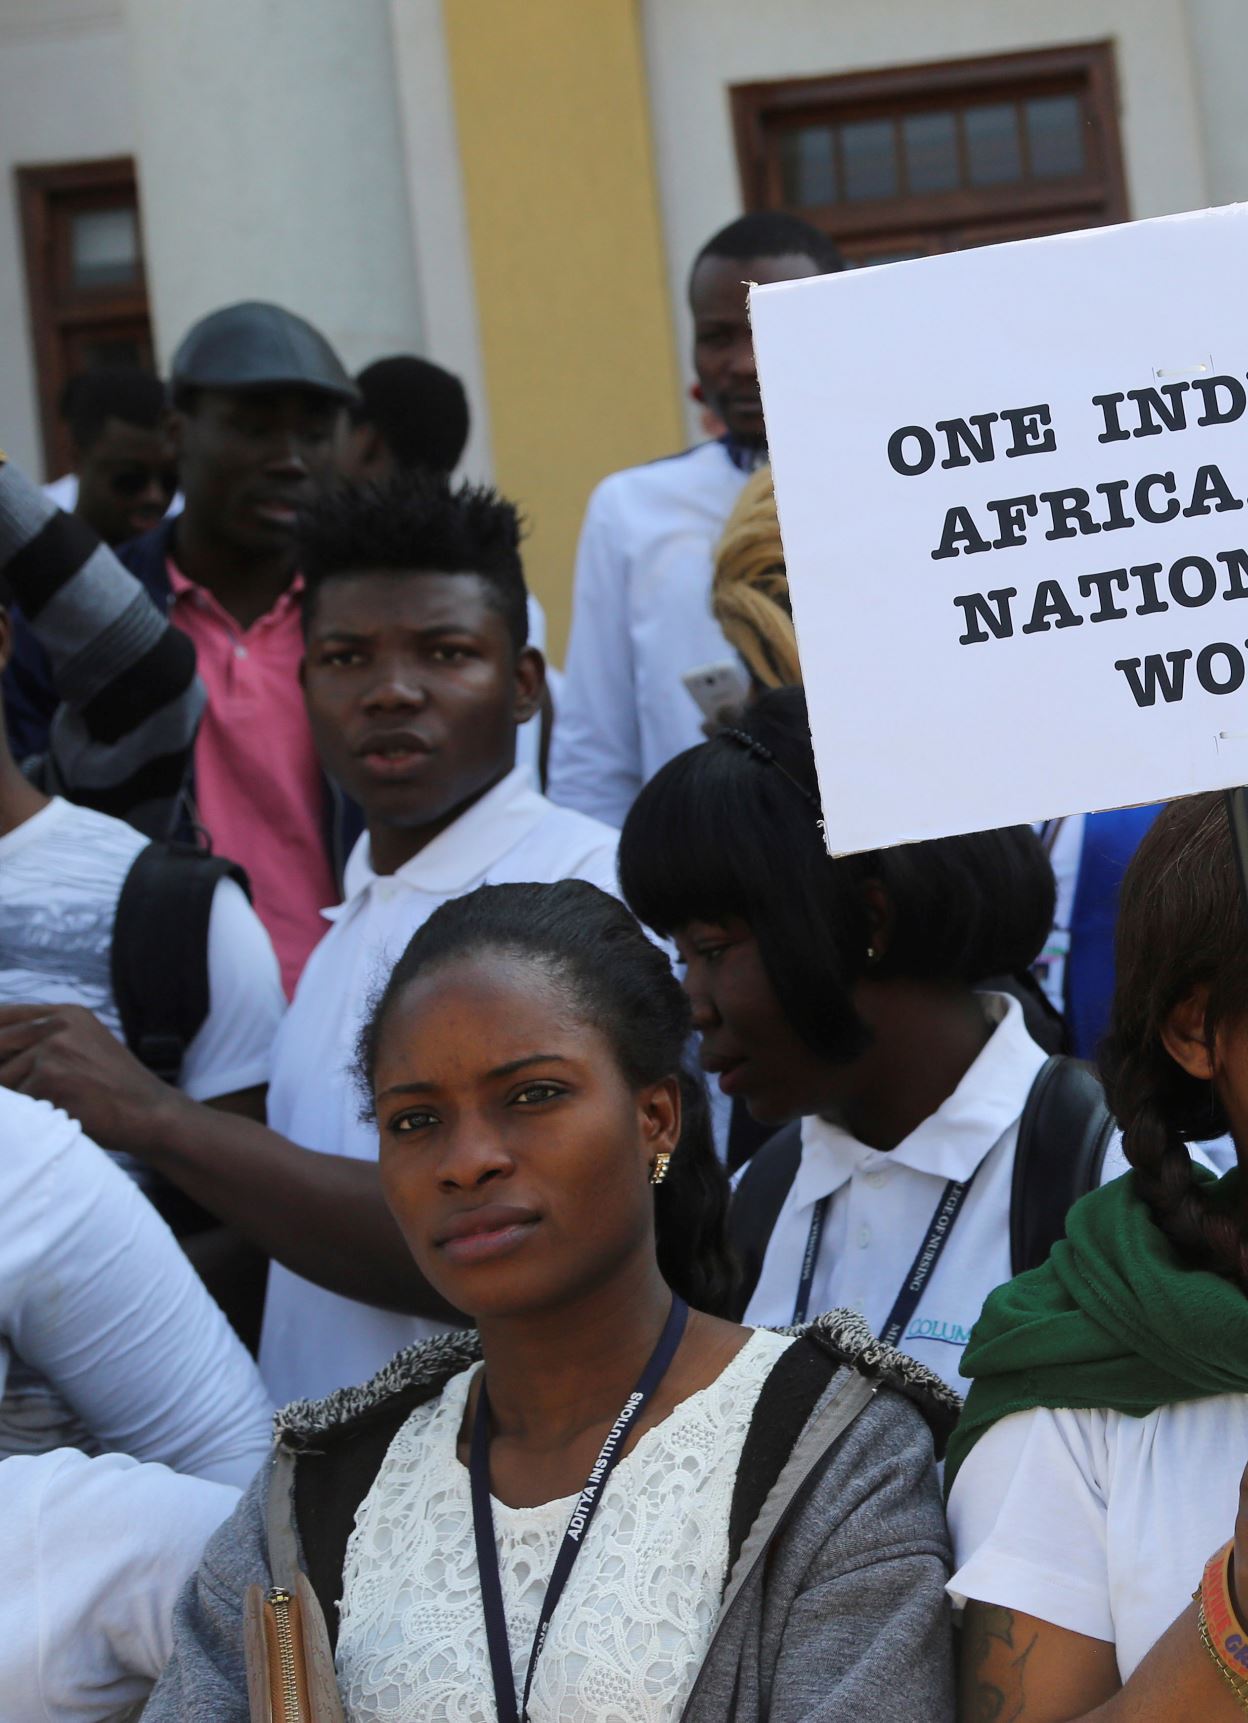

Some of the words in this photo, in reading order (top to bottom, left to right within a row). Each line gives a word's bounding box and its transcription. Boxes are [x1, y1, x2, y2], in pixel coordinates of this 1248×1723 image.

[888, 404, 1057, 476] ONE
[935, 1215, 949, 1235] OF
[909, 1234, 942, 1291] NURSING
[567, 1485, 598, 1542] ADITYA
[588, 1391, 644, 1484] INSTITUTIONS
